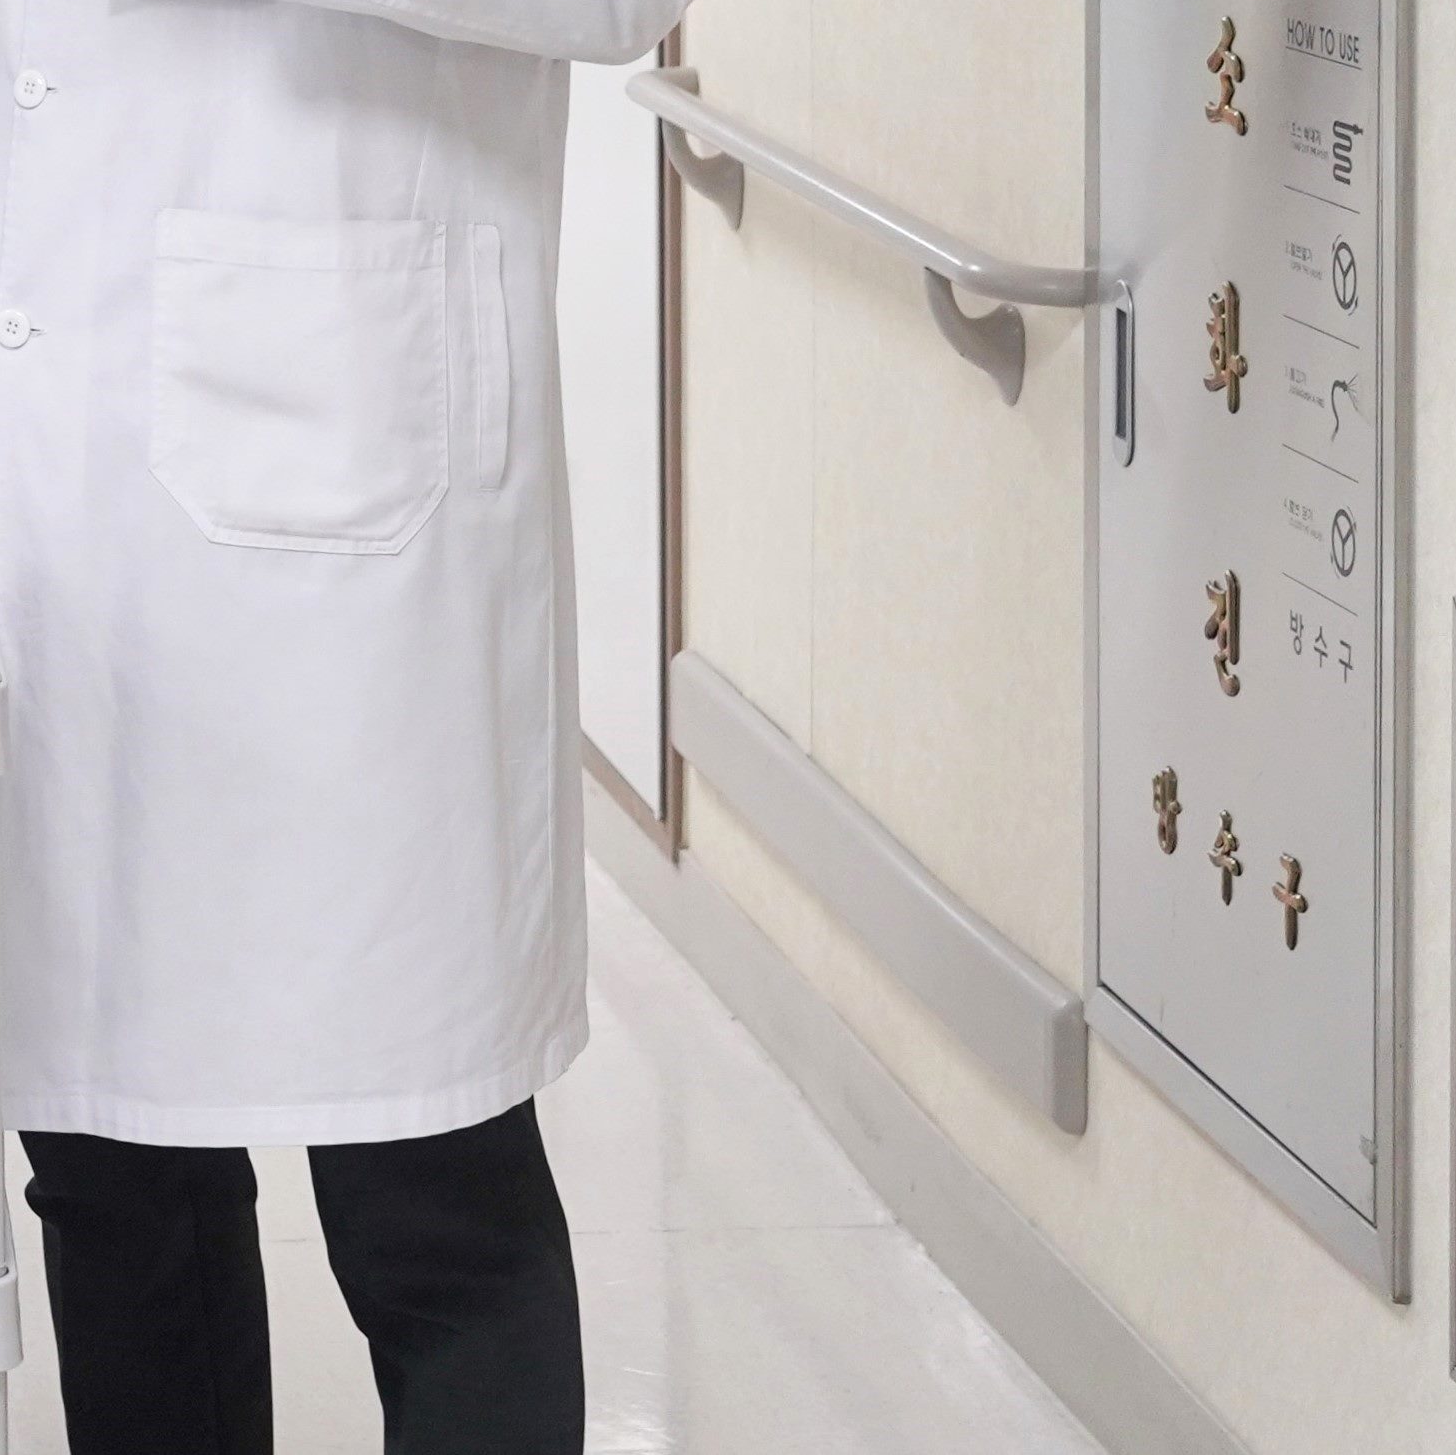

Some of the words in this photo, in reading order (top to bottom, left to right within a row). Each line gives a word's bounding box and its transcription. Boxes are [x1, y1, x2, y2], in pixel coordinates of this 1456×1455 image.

[1287, 17, 1315, 50] HOW
[1319, 26, 1335, 56] TO
[1338, 33, 1360, 64] USE
[1289, 609, 1353, 683] 방수구
